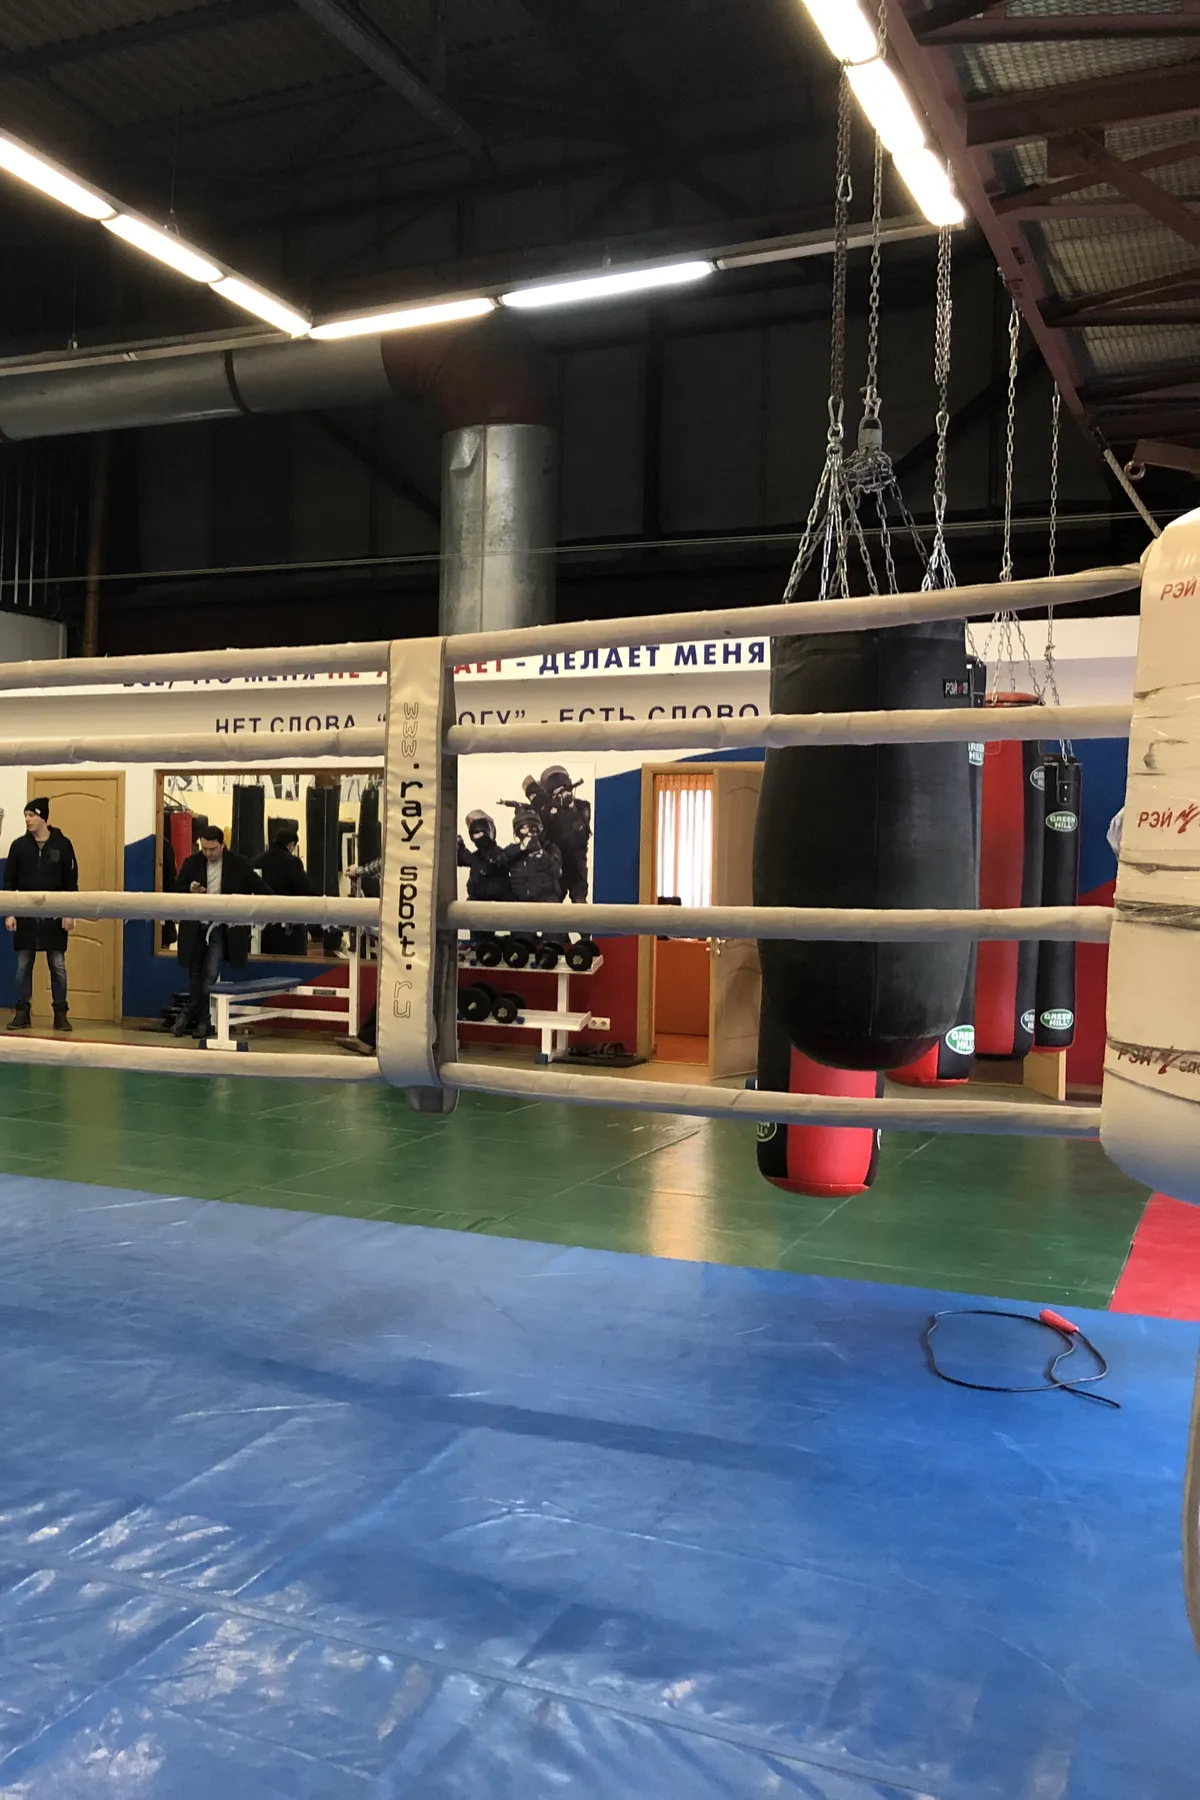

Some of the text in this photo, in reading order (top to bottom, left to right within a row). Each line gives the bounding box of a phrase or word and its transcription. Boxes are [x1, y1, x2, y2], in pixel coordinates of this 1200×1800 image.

[1160, 576, 1197, 601] РЭЙ
[539, 646, 660, 675] ДЕЛАЕТ
[674, 640, 766, 666] МЕНЯ
[1049, 813, 1076, 823] GREEN
[1137, 807, 1173, 829] РЭЙ
[392, 702, 425, 1019] www.ray-sport.ru
[1044, 1012, 1073, 1021] GREEN
